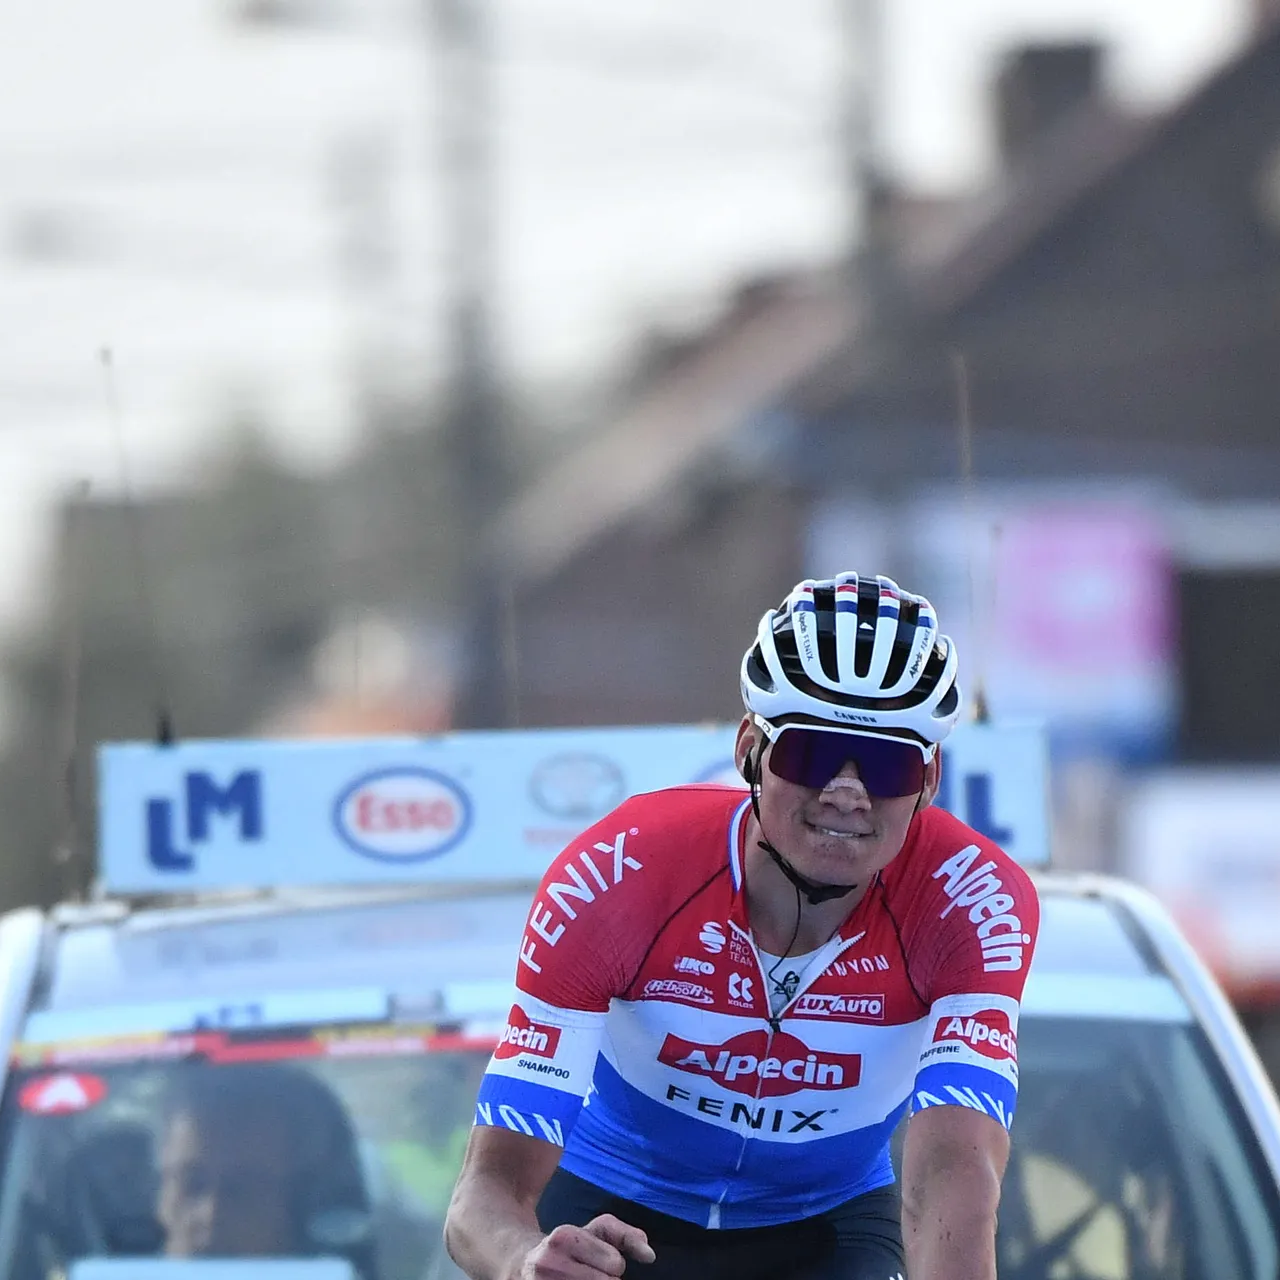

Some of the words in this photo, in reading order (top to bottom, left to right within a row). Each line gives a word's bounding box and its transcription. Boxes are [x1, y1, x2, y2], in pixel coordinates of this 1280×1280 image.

[833, 711, 878, 724] CANYON
[353, 793, 456, 833] Esso
[519, 831, 643, 975] FENIX
[932, 844, 1032, 973] Alpecin
[729, 941, 750, 956] PRO
[822, 954, 890, 976] NYON
[500, 1024, 549, 1052] pecin
[517, 1059, 570, 1079] SHAMPOO
[675, 1050, 844, 1085] Alpecin
[666, 1084, 827, 1133] FENIX
